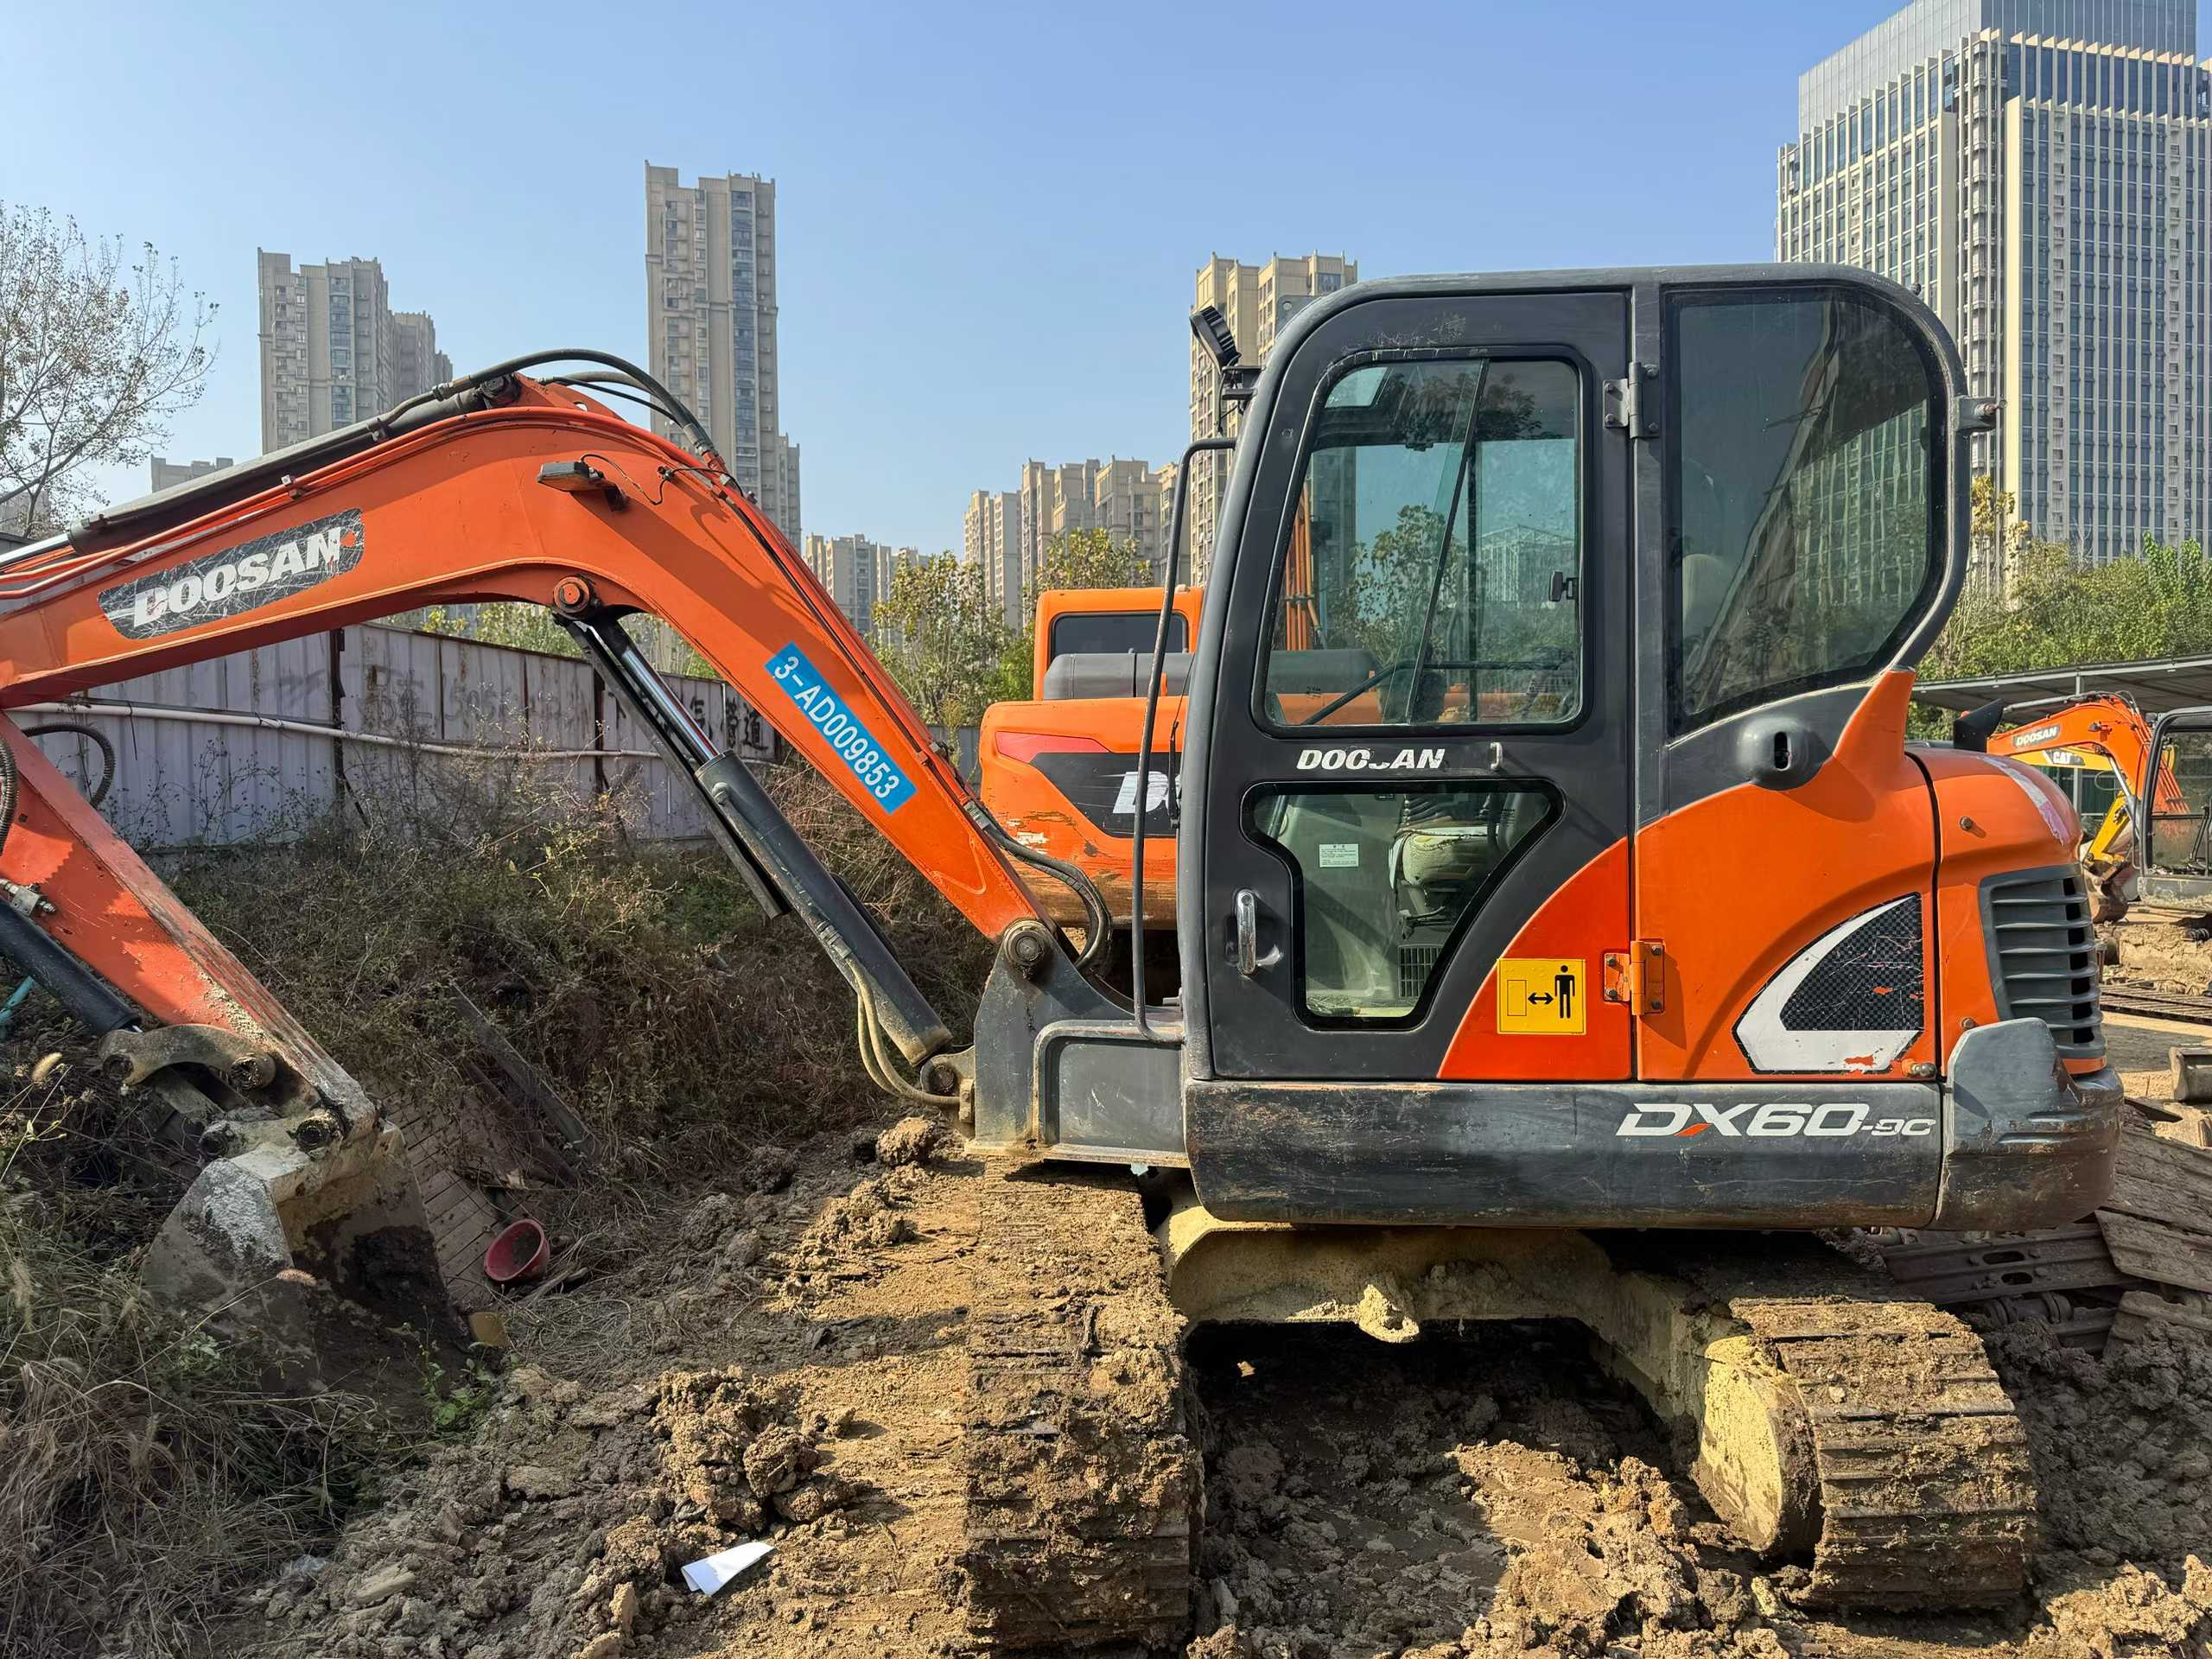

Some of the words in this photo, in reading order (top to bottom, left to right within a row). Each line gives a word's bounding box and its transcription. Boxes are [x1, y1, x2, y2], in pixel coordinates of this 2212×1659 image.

[134, 526, 341, 628] DOOSAN
[774, 656, 899, 799] 3-AD009853
[2015, 726, 2057, 747] DOOSAN
[1296, 748, 1446, 771] DOOAN
[2052, 751, 2074, 765] CAT
